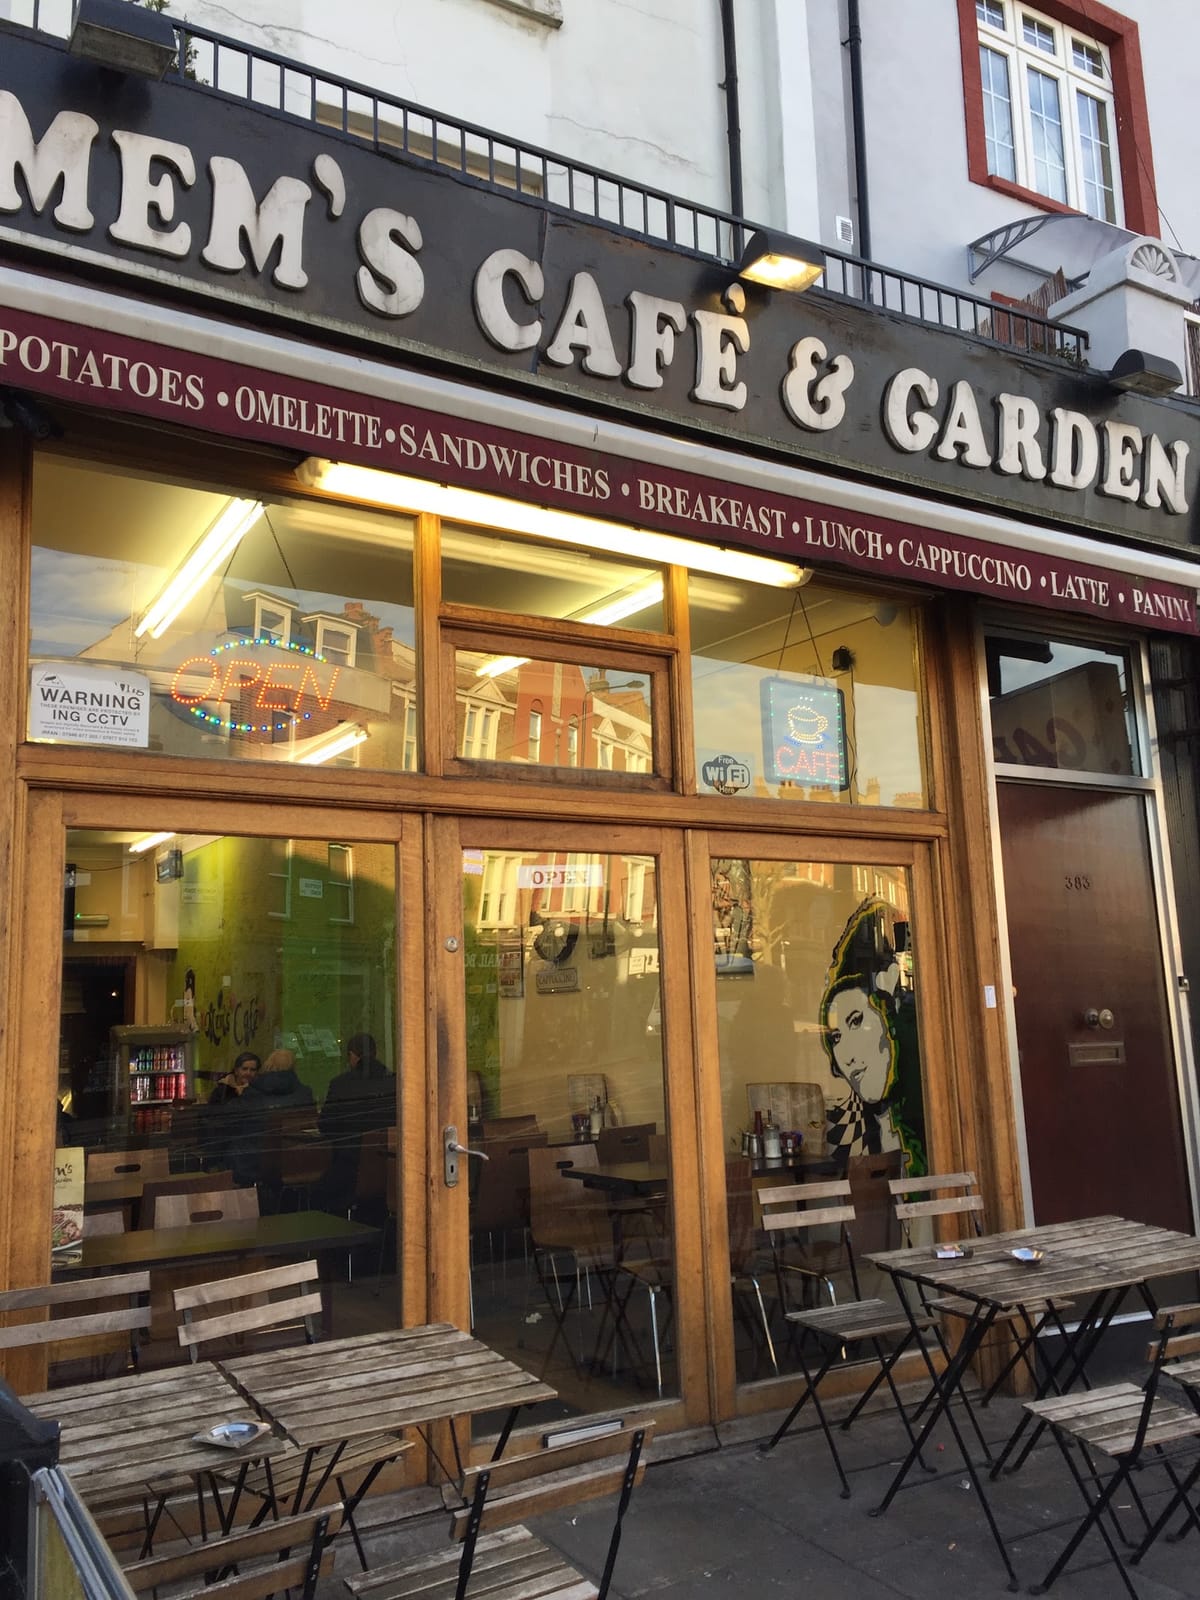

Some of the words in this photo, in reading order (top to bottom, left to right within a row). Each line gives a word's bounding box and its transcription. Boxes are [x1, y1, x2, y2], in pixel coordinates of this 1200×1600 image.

[0, 90, 425, 317] MEM'S
[782, 336, 855, 432] &
[884, 368, 1190, 515] GARDEN
[0, 329, 206, 411] POTATOES
[235, 385, 384, 450] OMELETTE
[399, 423, 611, 501] SANDWICHES
[637, 478, 787, 539] BREAKFAST
[805, 516, 884, 561] LUNCH
[898, 539, 1032, 592] CAPPUCCINO
[1050, 571, 1110, 608] LATTE
[171, 656, 341, 711] OPEN
[40, 687, 141, 711] WARNING
[53, 709, 81, 722] ING
[87, 712, 129, 727] CCTV
[718, 755, 734, 764] Free
[775, 746, 841, 780] CAFE
[719, 785, 735, 794] Here
